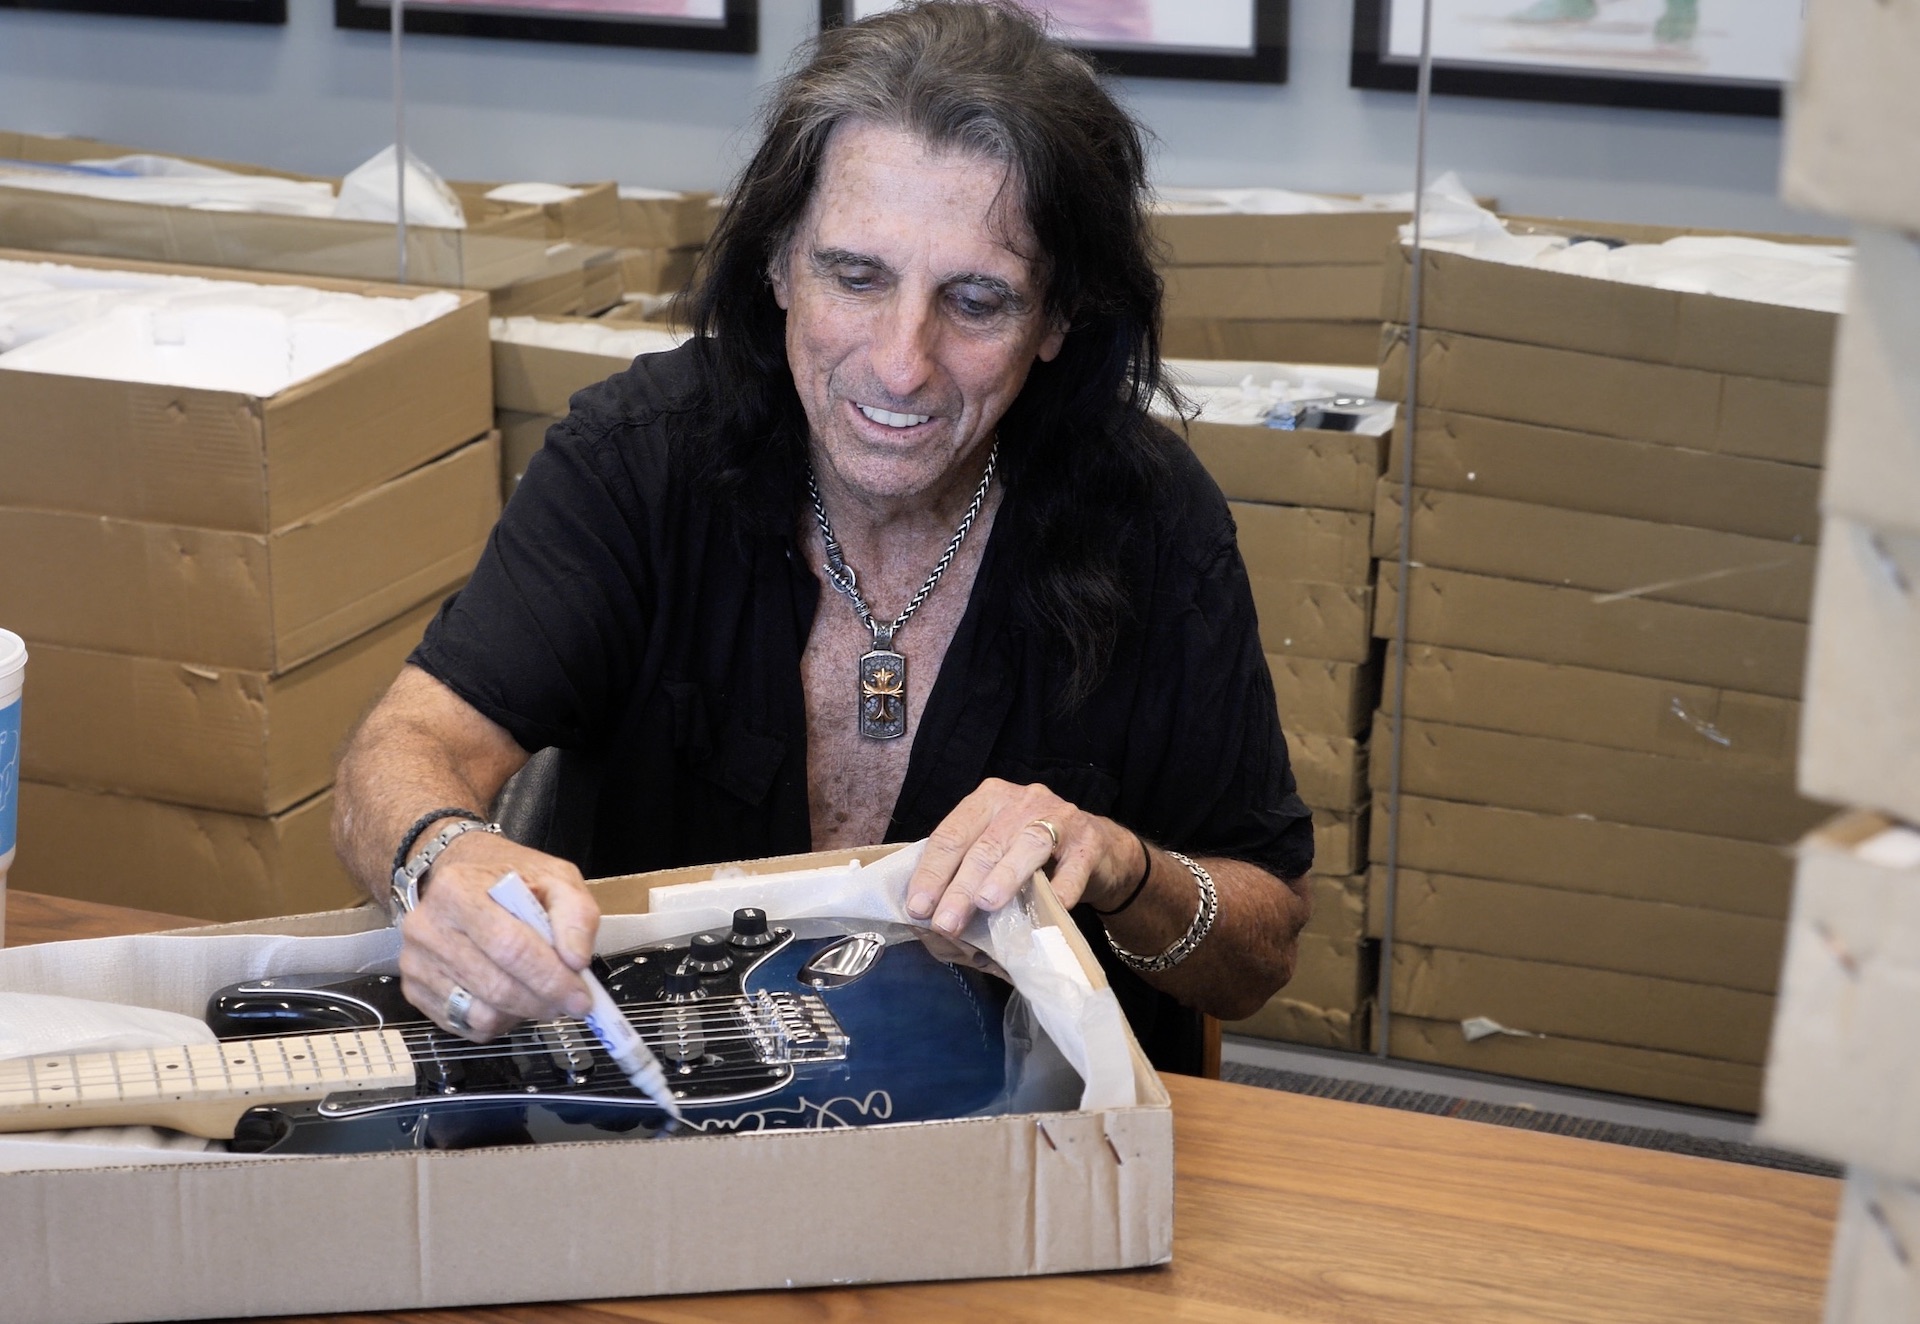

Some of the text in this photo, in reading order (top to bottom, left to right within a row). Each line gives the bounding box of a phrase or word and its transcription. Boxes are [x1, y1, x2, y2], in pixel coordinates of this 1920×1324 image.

[741, 936, 748, 945] 2
[754, 936, 761, 945] 3
[700, 963, 706, 971] 7
[665, 993, 673, 1002] 2
